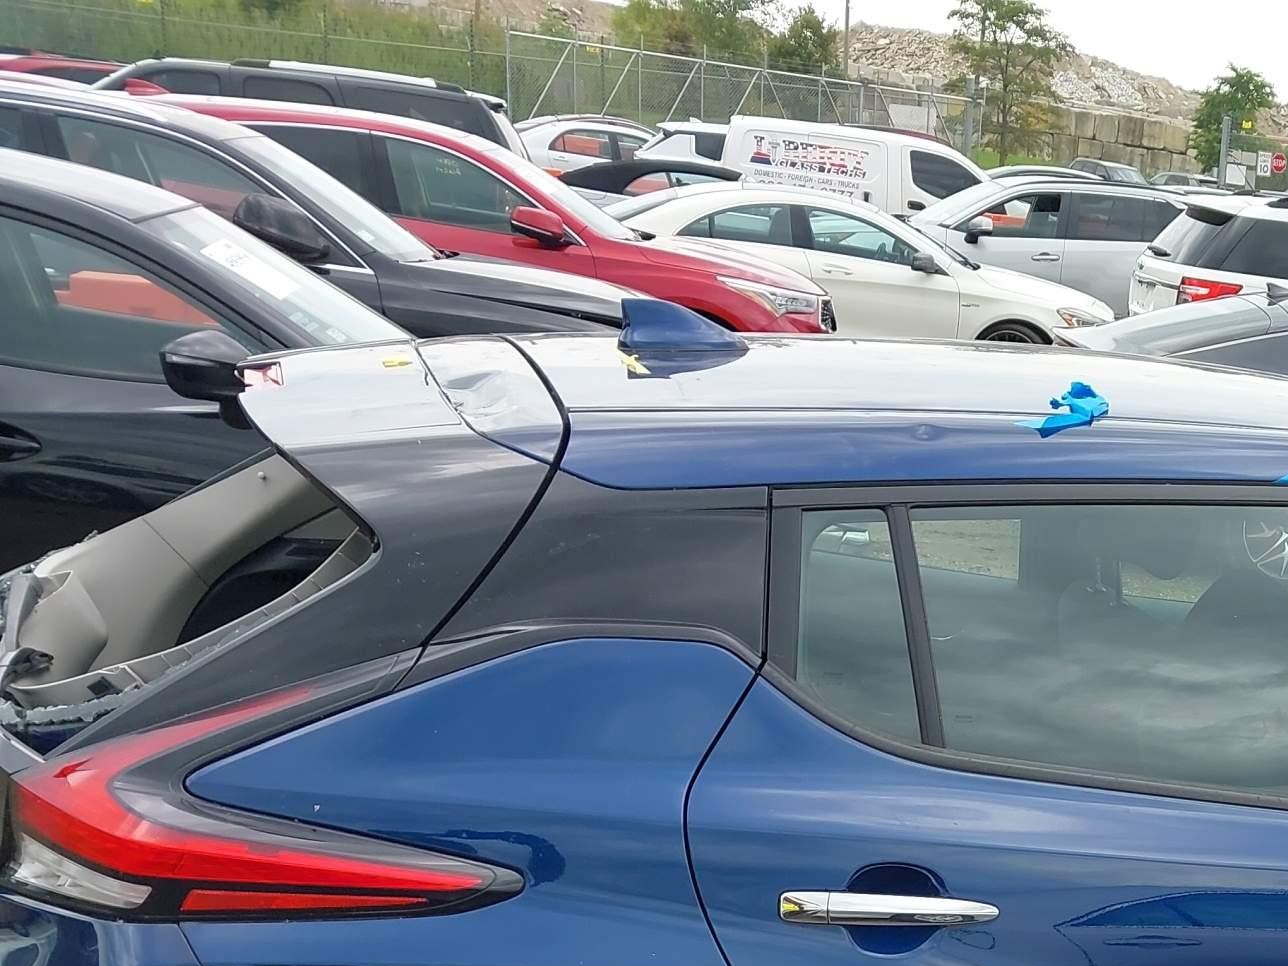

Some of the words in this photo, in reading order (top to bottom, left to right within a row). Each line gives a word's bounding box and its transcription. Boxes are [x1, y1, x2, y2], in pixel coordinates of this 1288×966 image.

[776, 158, 819, 172] GLASS
[1273, 158, 1286, 167] STOP
[1259, 164, 1269, 174] 10
[754, 168, 784, 179] DOMESTIC
[788, 173, 814, 184] FOREIGN
[818, 178, 833, 186] CARS
[837, 180, 860, 190] TRUCKS
